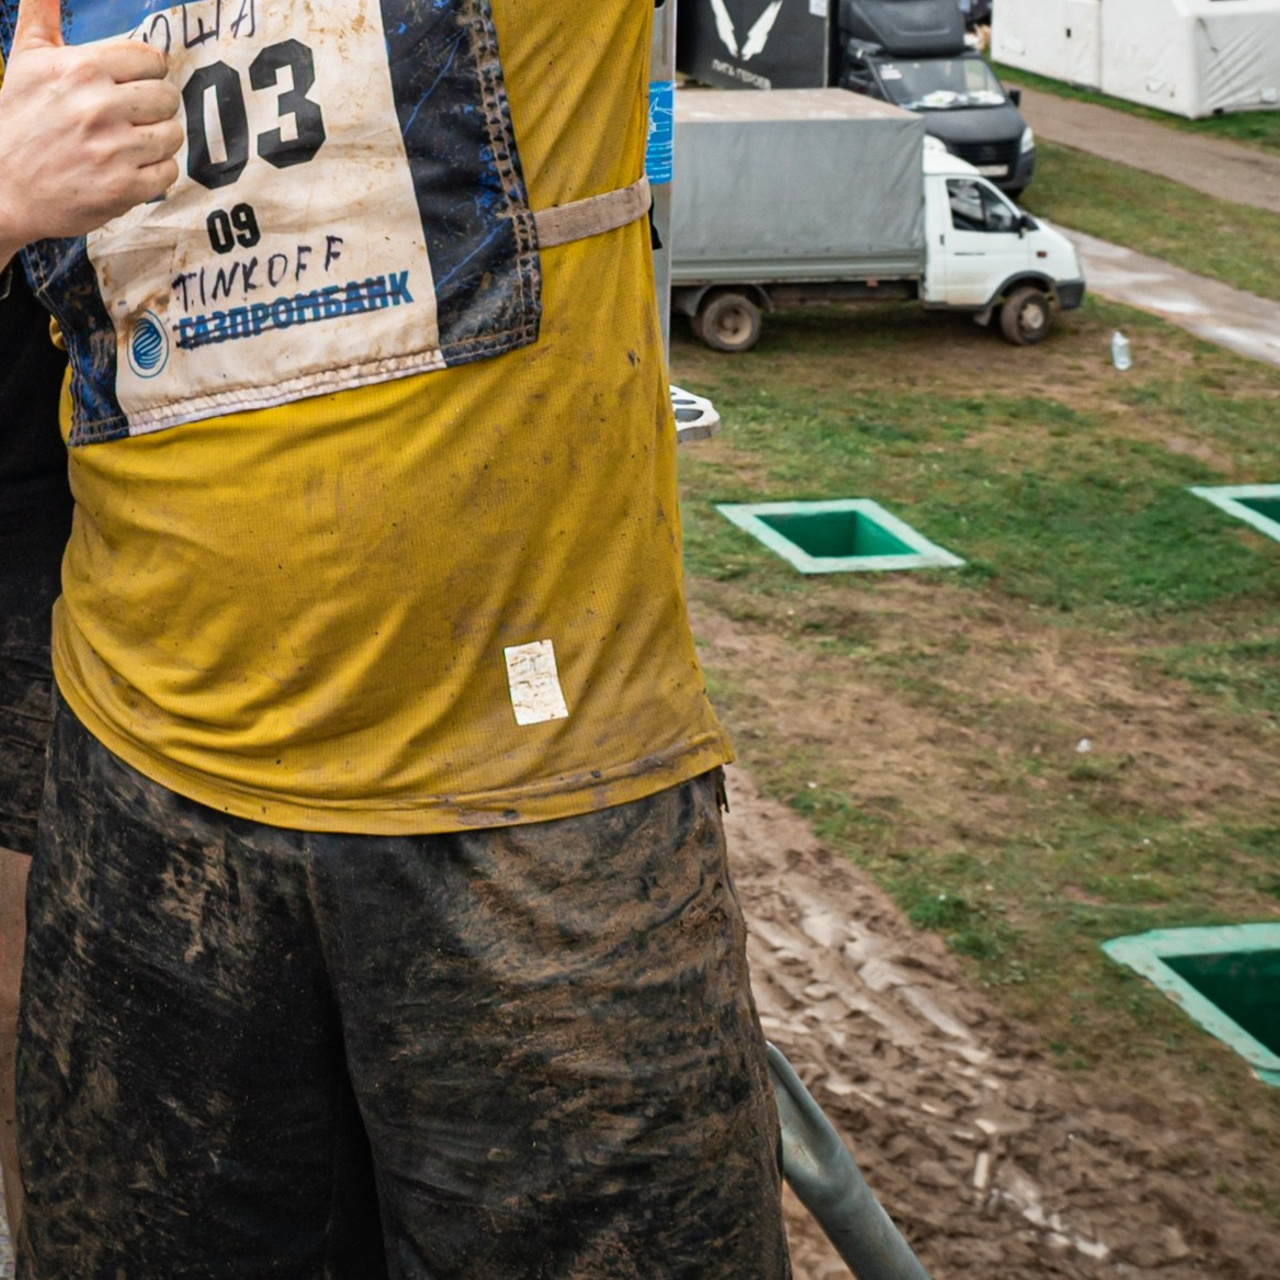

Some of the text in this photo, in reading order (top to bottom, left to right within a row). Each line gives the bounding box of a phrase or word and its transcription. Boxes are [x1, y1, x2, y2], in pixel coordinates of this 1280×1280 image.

[206, 202, 261, 254] 09
[172, 235, 344, 313] TINKOFF
[177, 270, 414, 350] ГАЗПРОМБАНК
